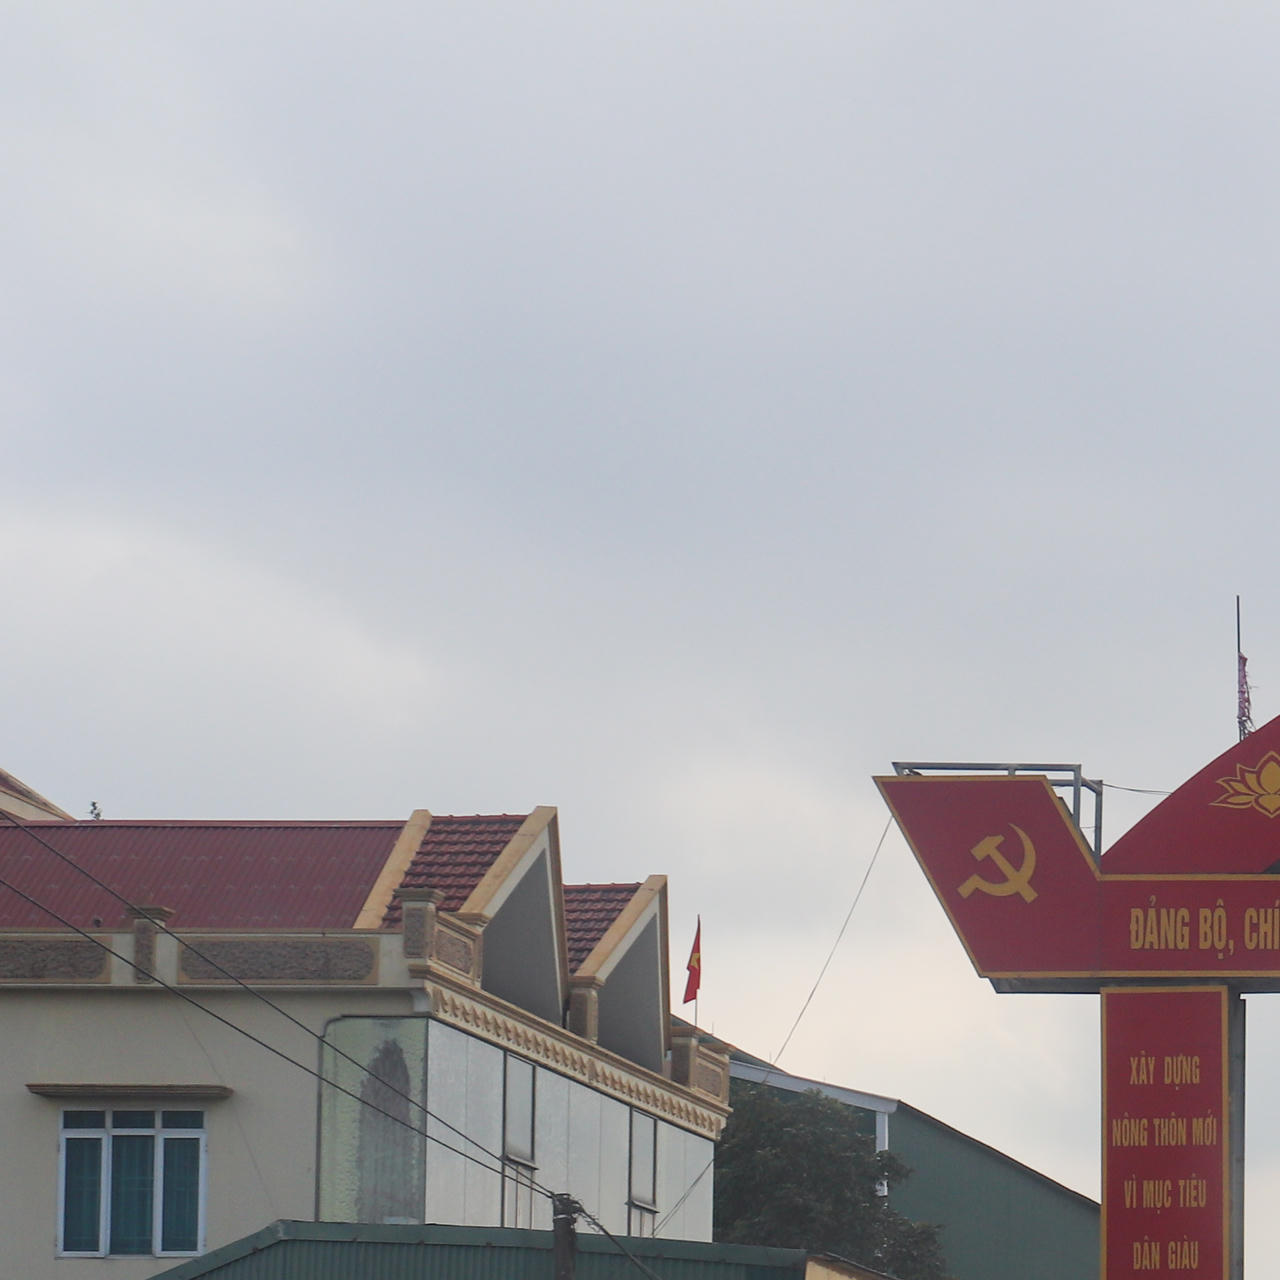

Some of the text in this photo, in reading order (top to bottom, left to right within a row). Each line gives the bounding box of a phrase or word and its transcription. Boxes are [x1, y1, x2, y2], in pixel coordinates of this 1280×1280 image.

[1130, 896, 1190, 950] ĐẢNG
[1130, 1050, 1200, 1090] XÂY DỰNG
[1112, 1109, 1217, 1147] NÔNG THÔN MỚI
[1124, 1173, 1207, 1214] VÌ MỤC TIÊU
[1133, 1235, 1199, 1270] DÂN GIÀU
